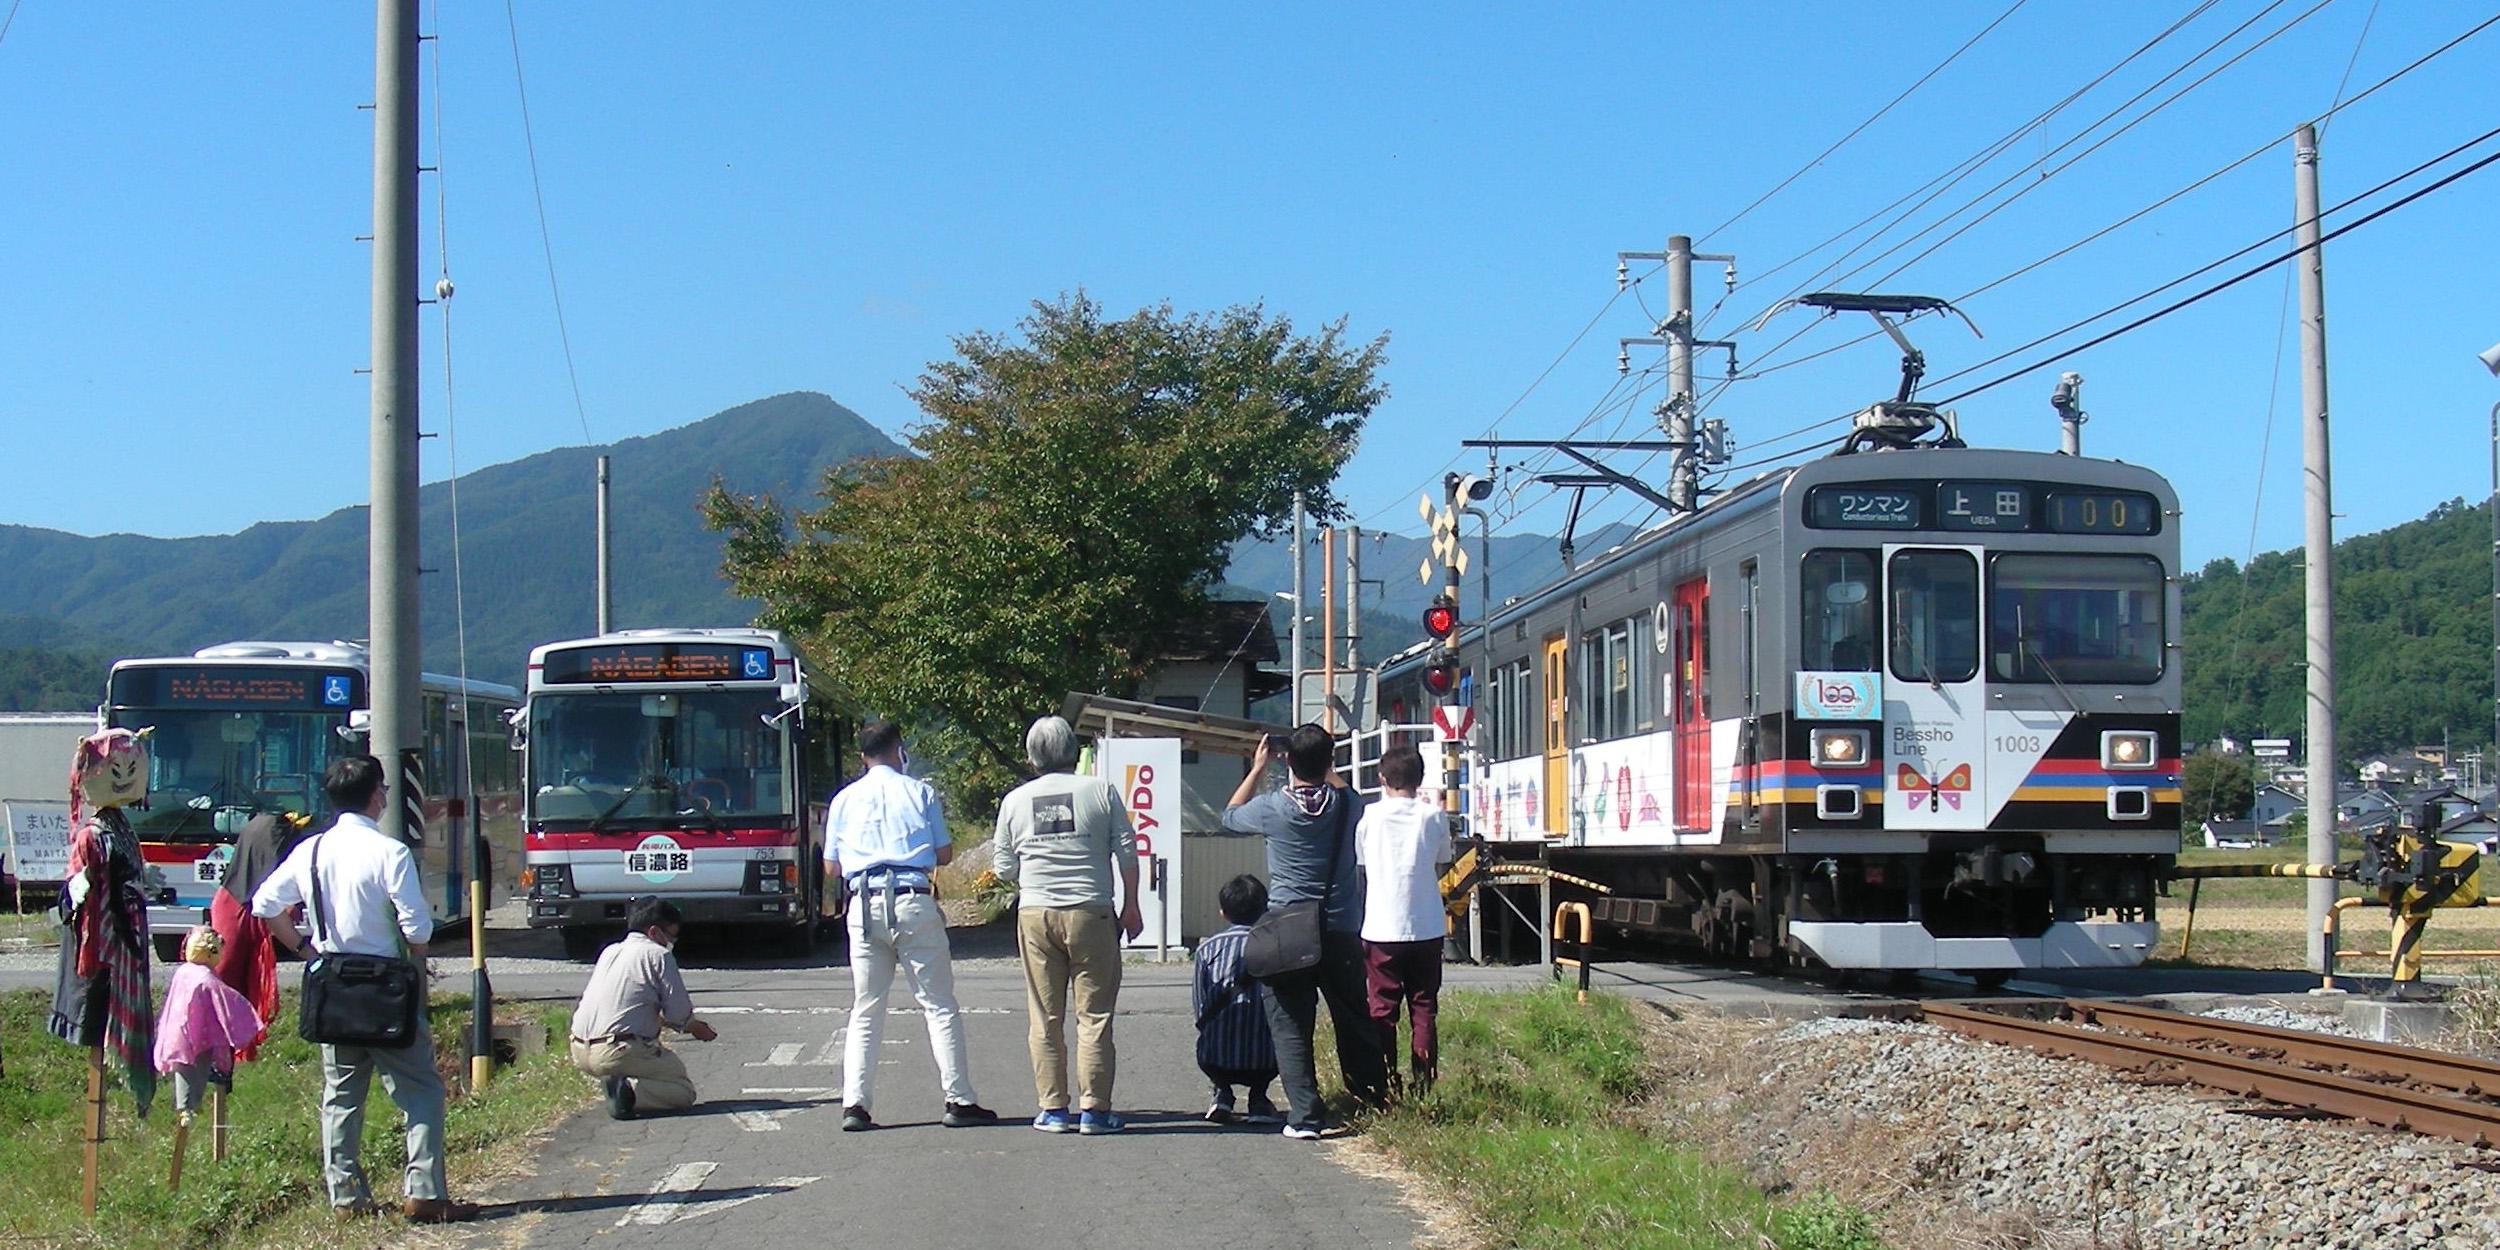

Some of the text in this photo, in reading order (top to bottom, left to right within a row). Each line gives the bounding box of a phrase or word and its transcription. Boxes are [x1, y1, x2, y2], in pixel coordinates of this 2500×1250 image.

[1839, 495, 1910, 512] ワンマン
[1891, 513, 1908, 521] Train
[1970, 517, 1996, 525] UEDA
[1893, 727, 1954, 741] Bessho
[1893, 742, 1927, 755] Line
[1994, 736, 2040, 752] 1003
[1133, 765, 1159, 856] DyDo
[755, 848, 775, 860] 753
[628, 853, 689, 872] 信濃路
